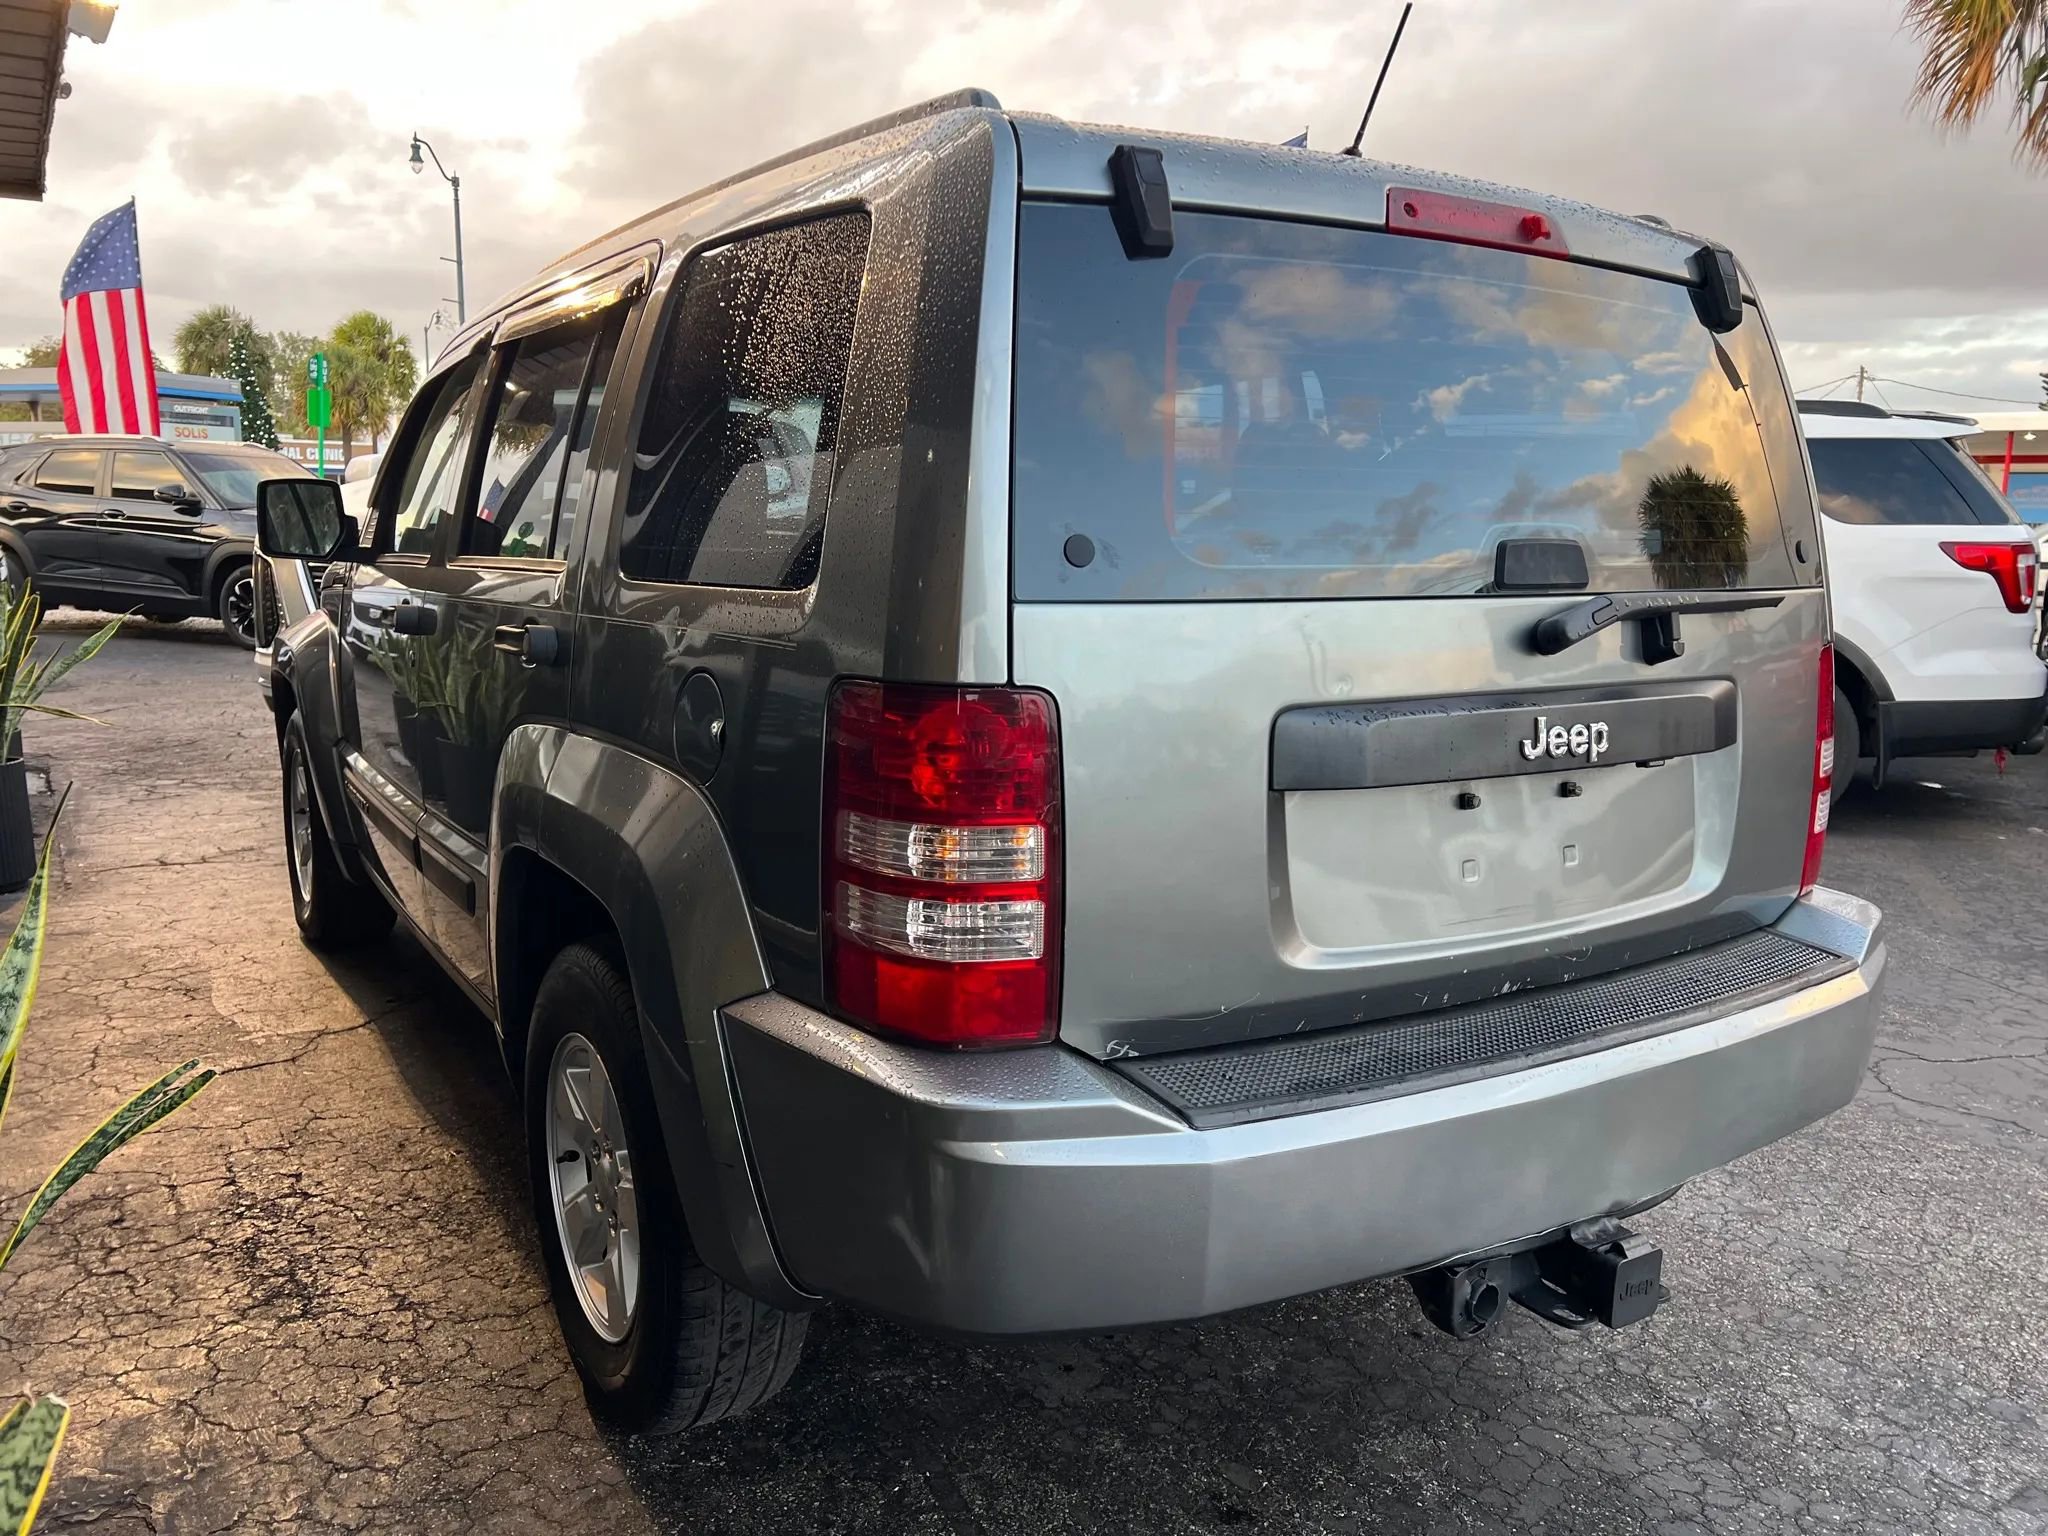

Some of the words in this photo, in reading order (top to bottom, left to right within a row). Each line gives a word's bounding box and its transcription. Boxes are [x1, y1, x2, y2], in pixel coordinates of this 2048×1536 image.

[174, 426, 209, 439] SOLIS
[1520, 716, 1609, 763] Jeep
[1619, 1279, 1653, 1301] Jeep
